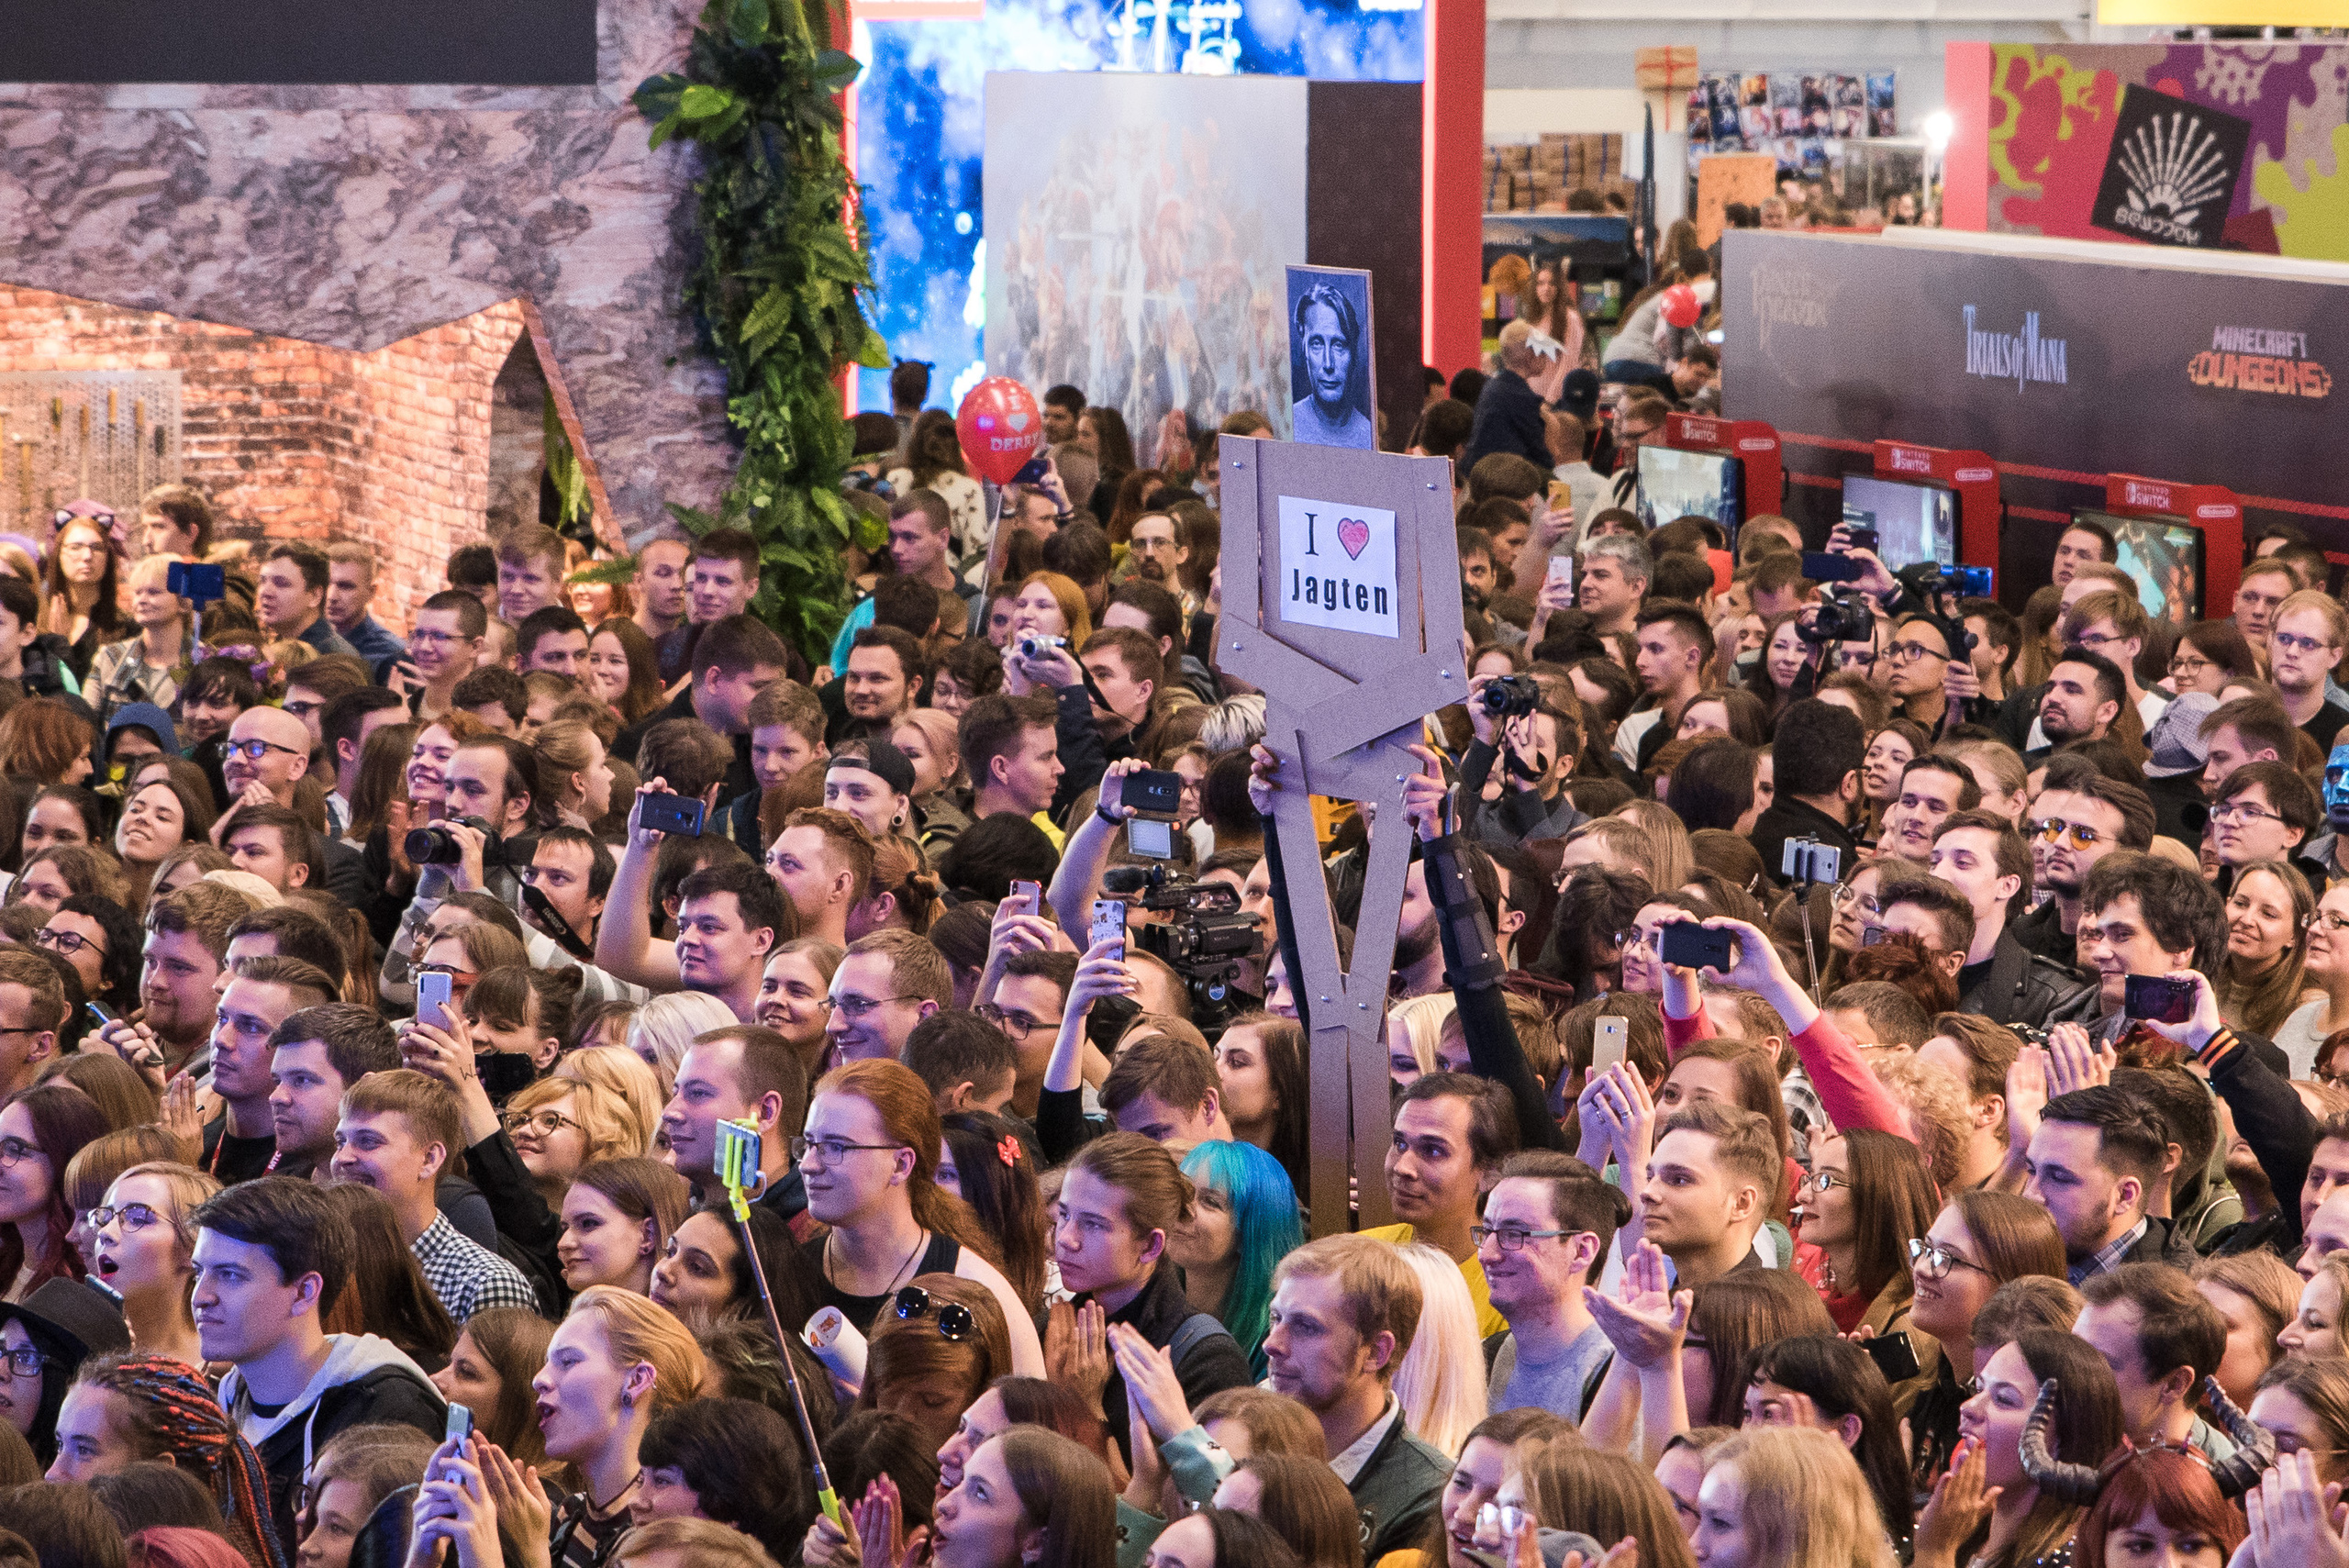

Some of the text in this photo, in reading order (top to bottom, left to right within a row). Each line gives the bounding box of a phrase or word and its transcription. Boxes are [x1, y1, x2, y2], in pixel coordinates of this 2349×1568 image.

[2212, 326, 2308, 359] MINECRAFT
[2192, 351, 2328, 398] DUNGEONS
[2136, 494, 2170, 509] SWITCH
[1305, 512, 1319, 556] I
[1292, 568, 1387, 616] Jagten
